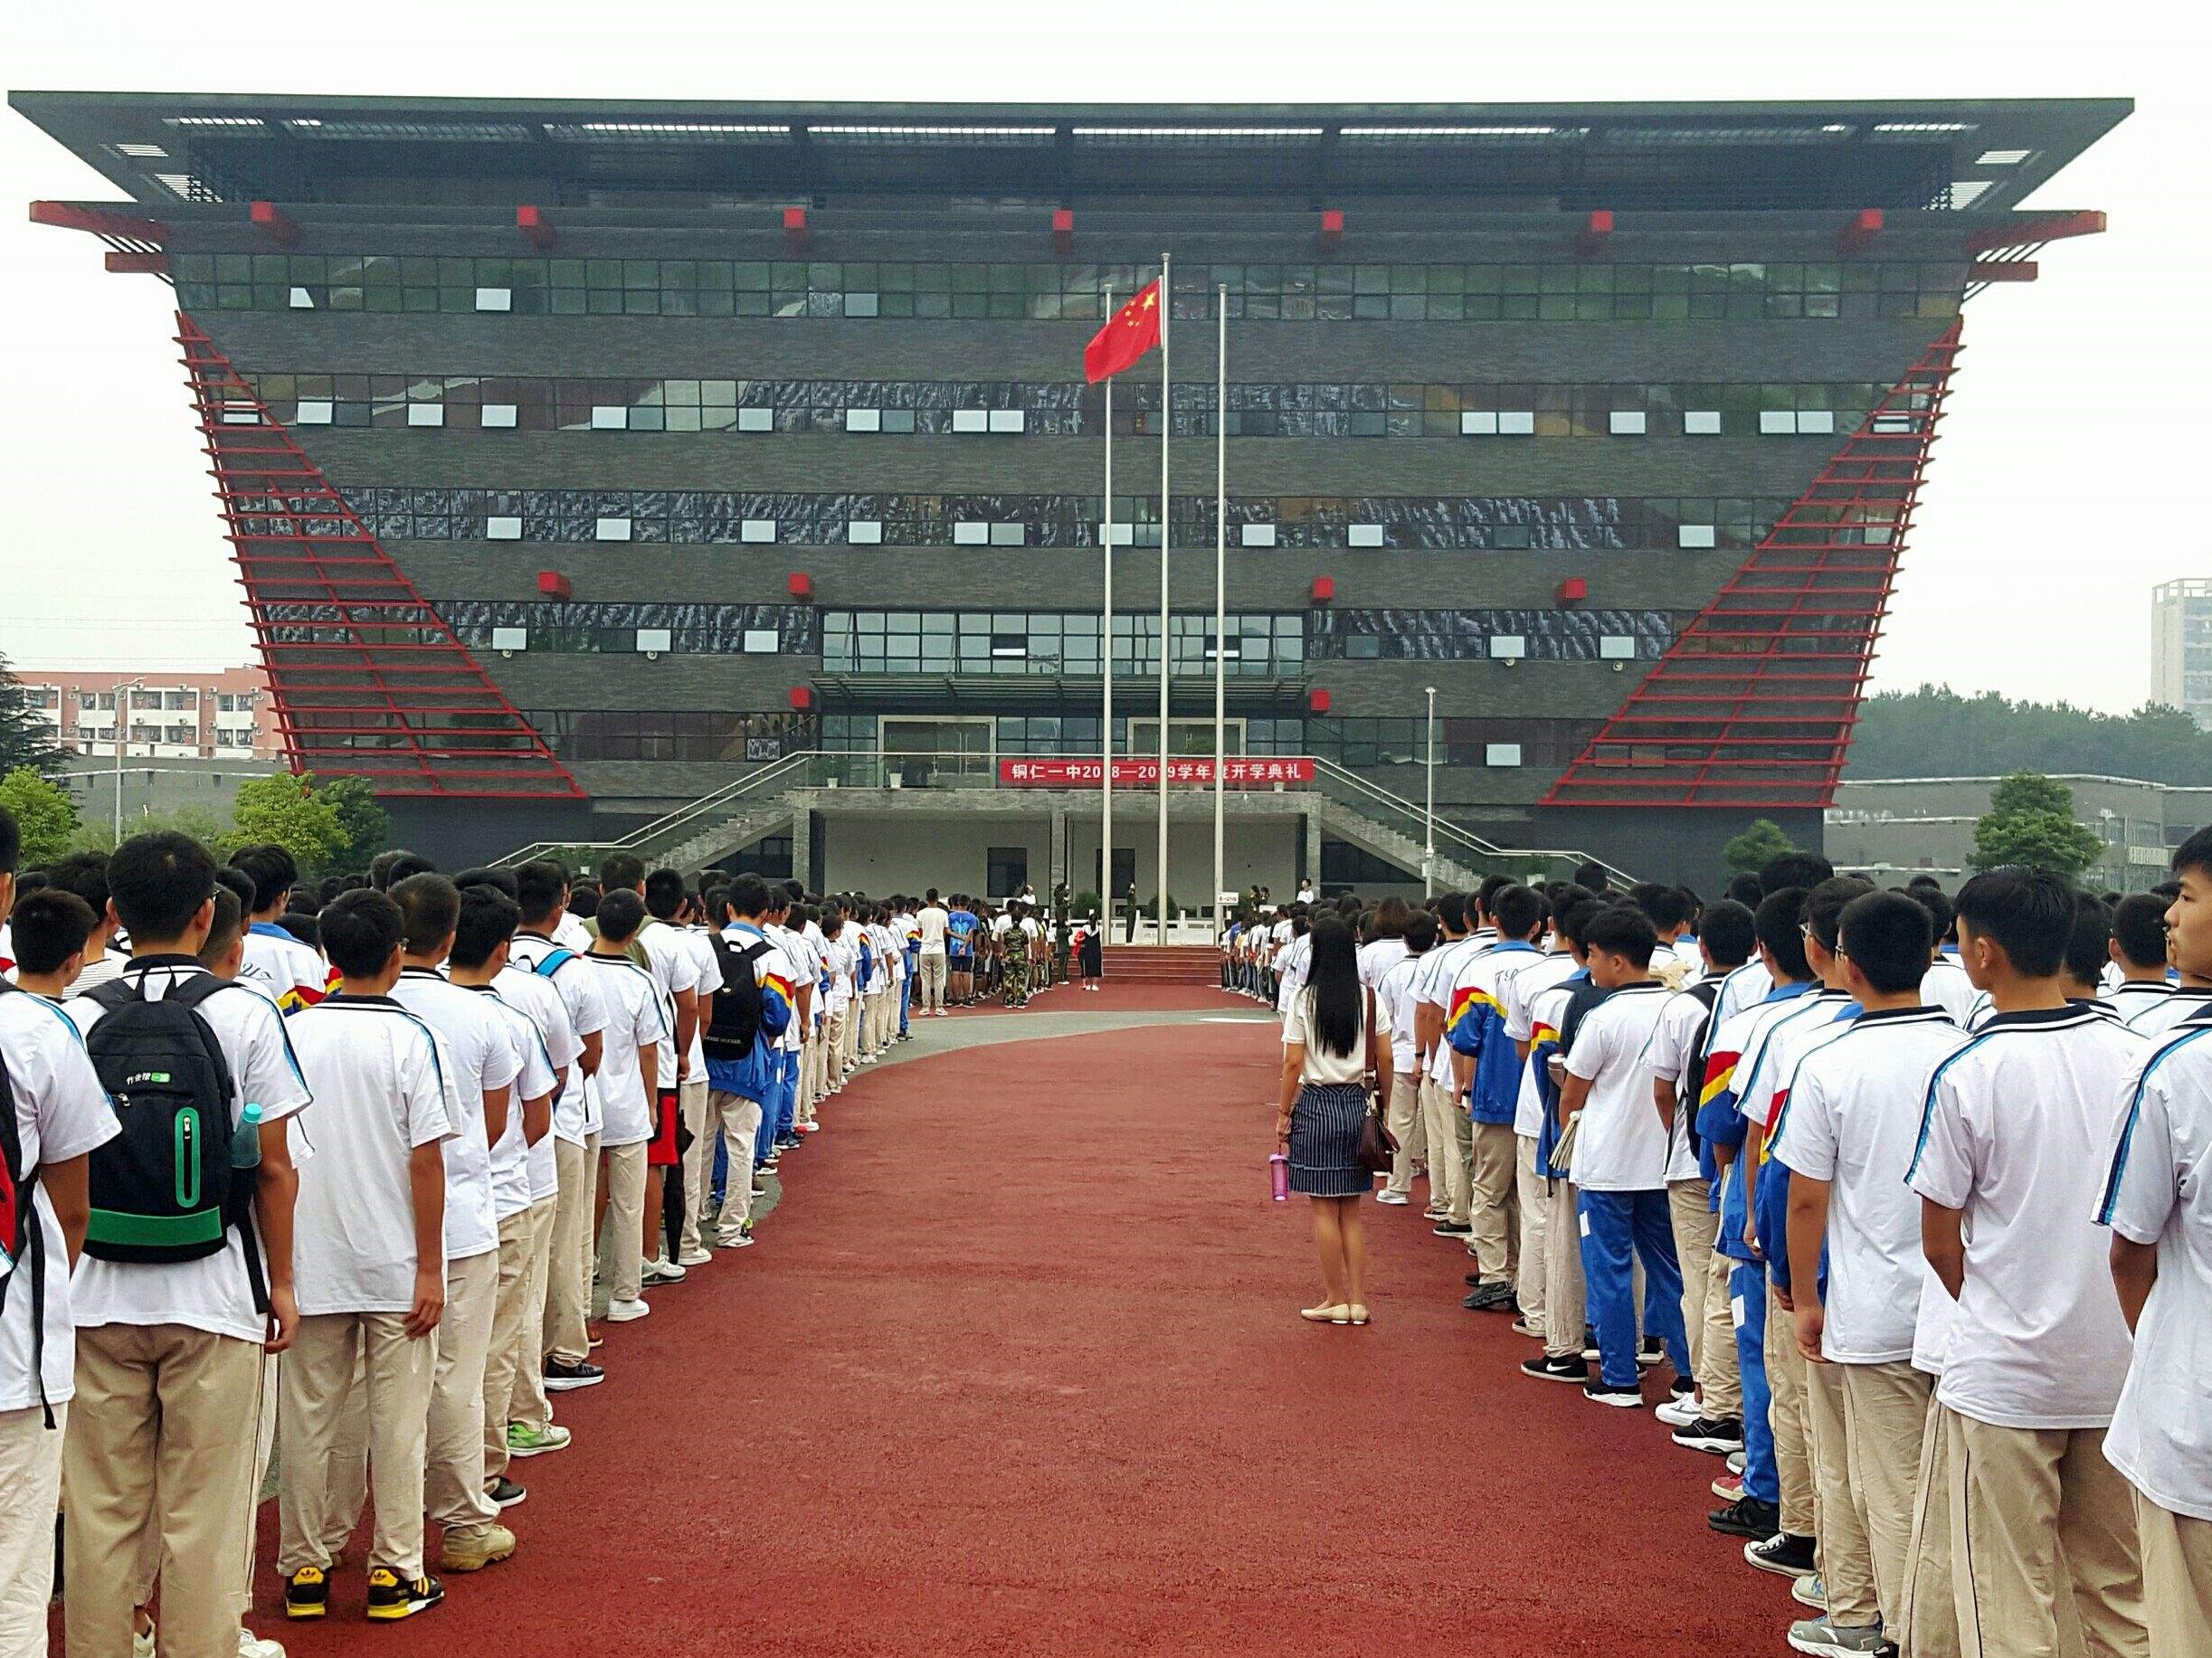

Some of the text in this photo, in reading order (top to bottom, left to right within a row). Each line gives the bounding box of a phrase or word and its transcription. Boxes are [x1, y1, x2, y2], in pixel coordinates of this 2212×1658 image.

[1011, 763, 1301, 780] 铜仁一中208—209学年开学典礼
